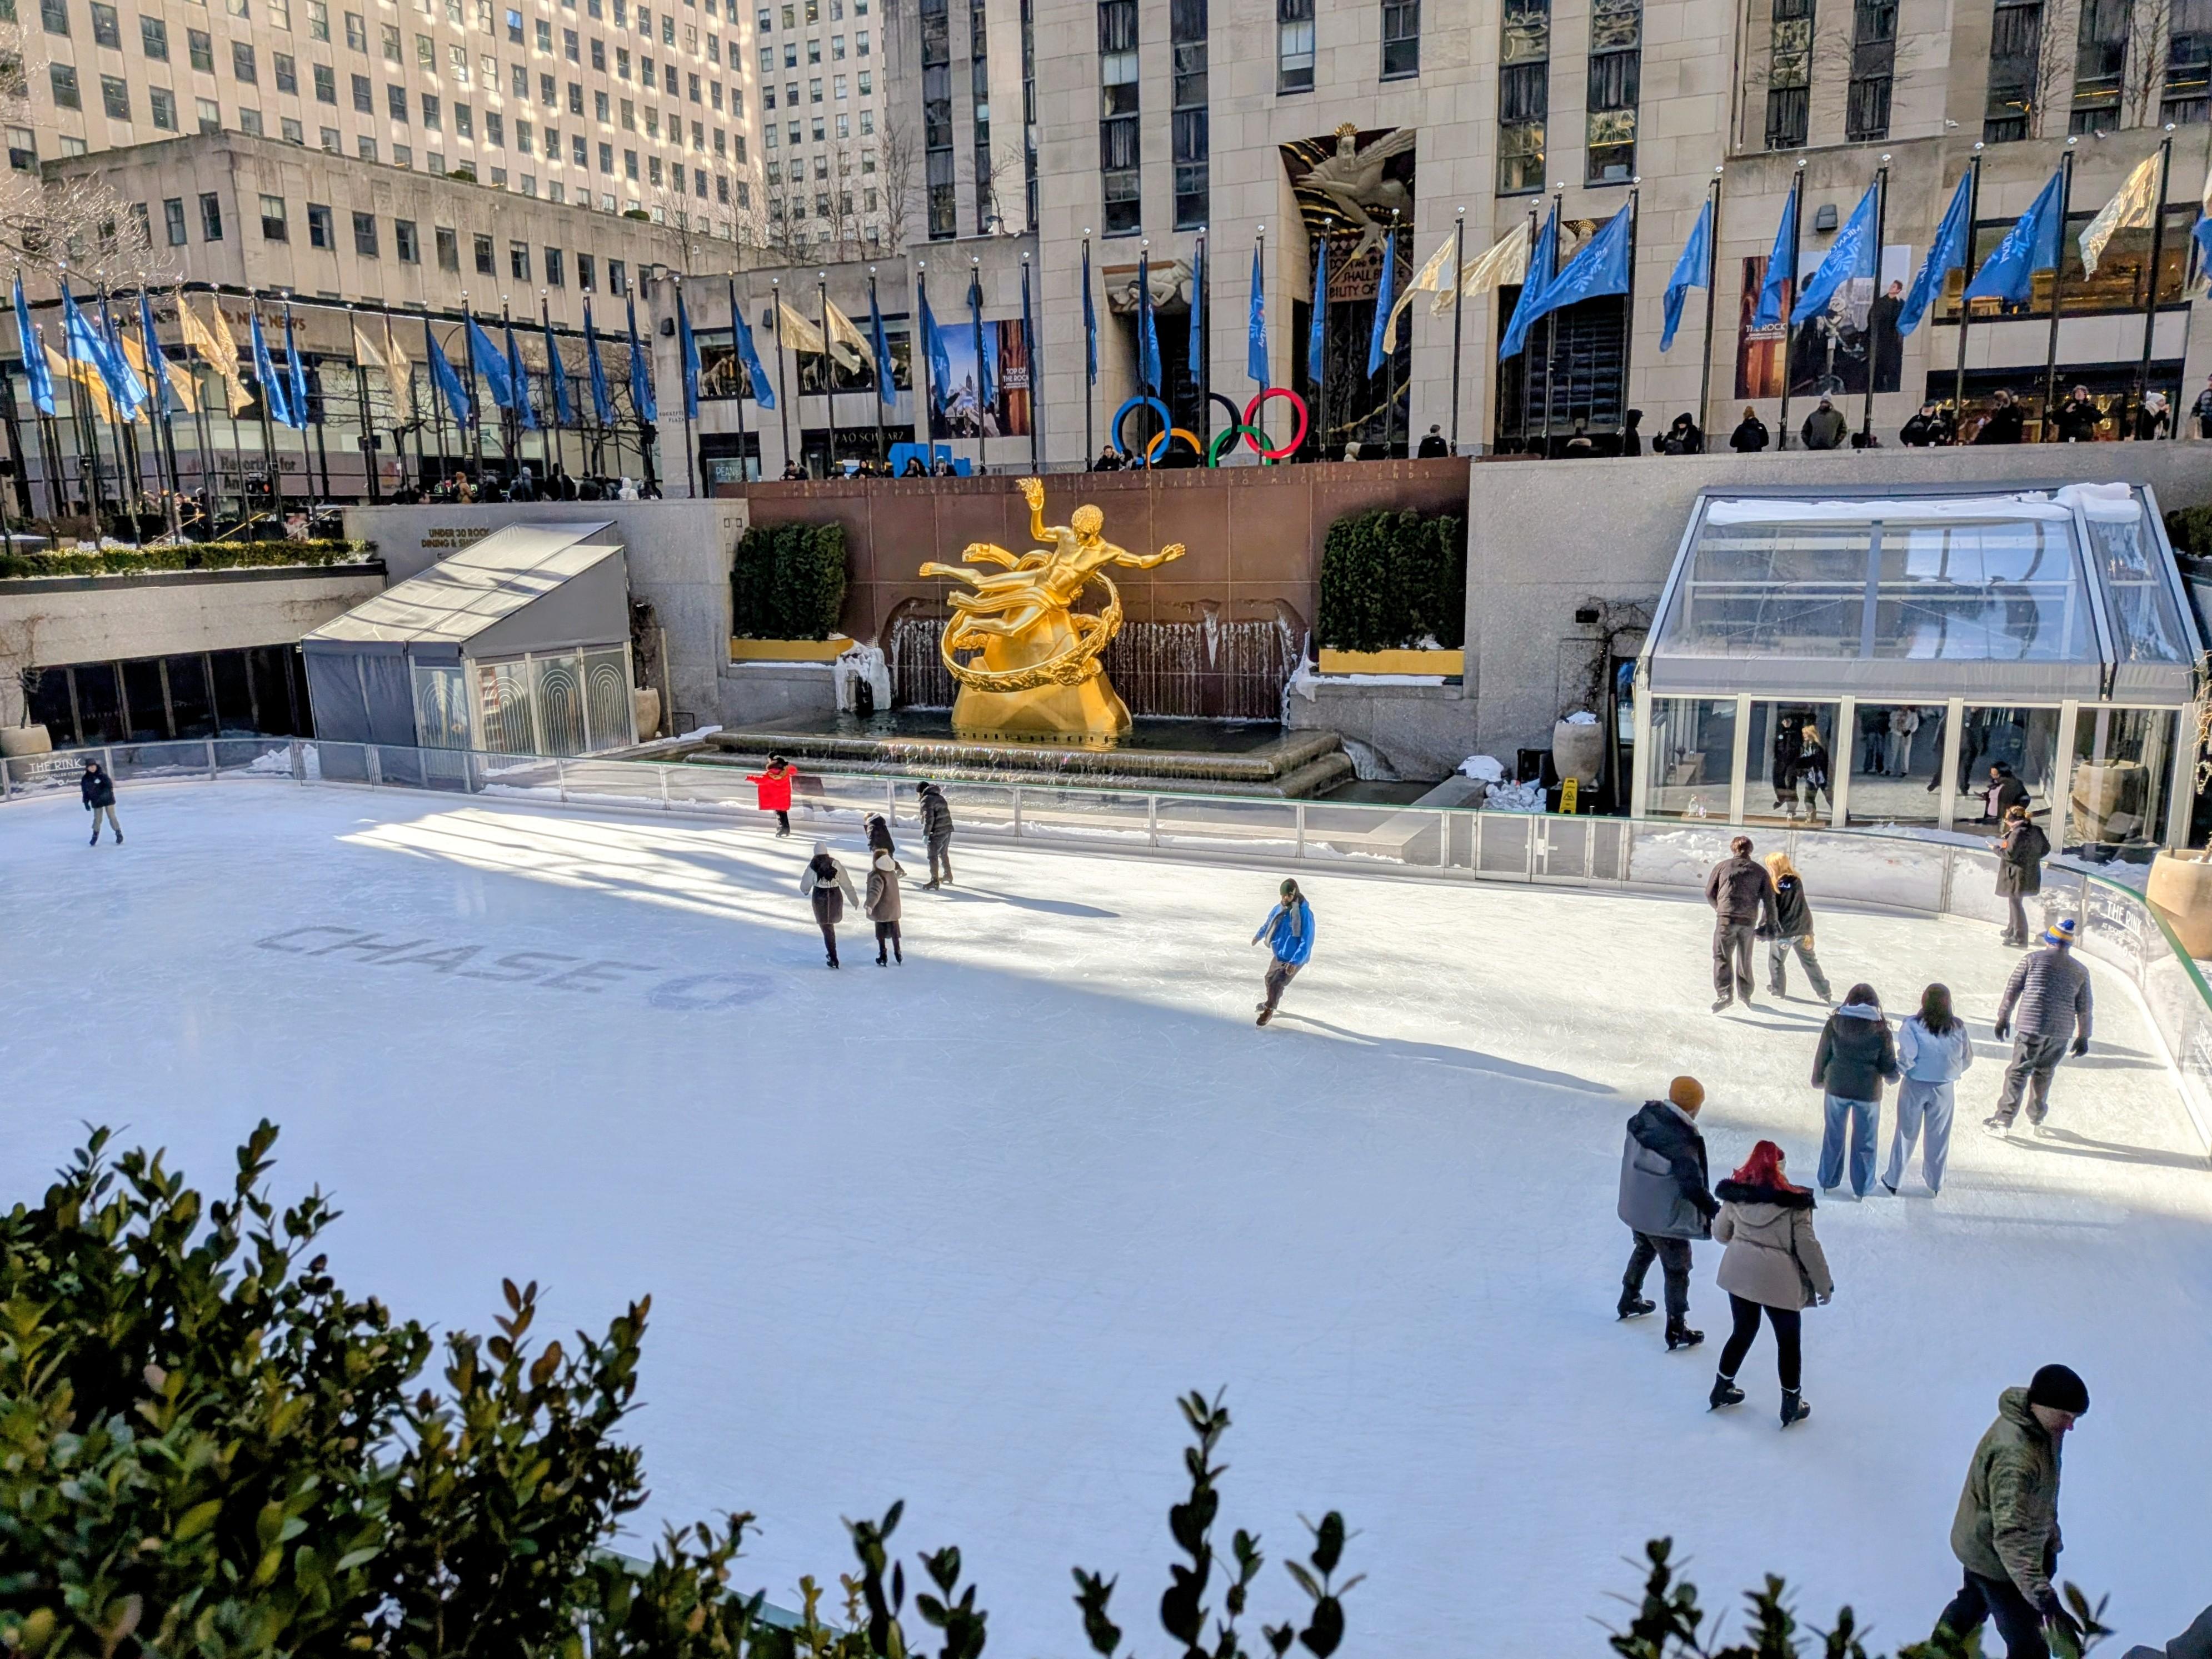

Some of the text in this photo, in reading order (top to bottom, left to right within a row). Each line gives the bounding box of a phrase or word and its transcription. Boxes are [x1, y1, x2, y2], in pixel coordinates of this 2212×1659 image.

[1342, 269, 1370, 282] SHALL
[1362, 283, 1376, 295] OF
[237, 311, 266, 327] NC
[1762, 322, 1787, 332] ROCK
[1018, 366, 1026, 374] OF
[835, 432, 856, 443] FAO
[1145, 480, 1206, 489] MEANS
[1229, 477, 1249, 486] TO
[1377, 471, 1430, 481] ENDS
[428, 528, 490, 537] UNDER 30 ROCK
[422, 539, 450, 548] DINING
[451, 539, 457, 547] &
[29, 758, 82, 772] THE RINK
[2107, 900, 2143, 935] THE RINK
[254, 924, 662, 993] CHASE
